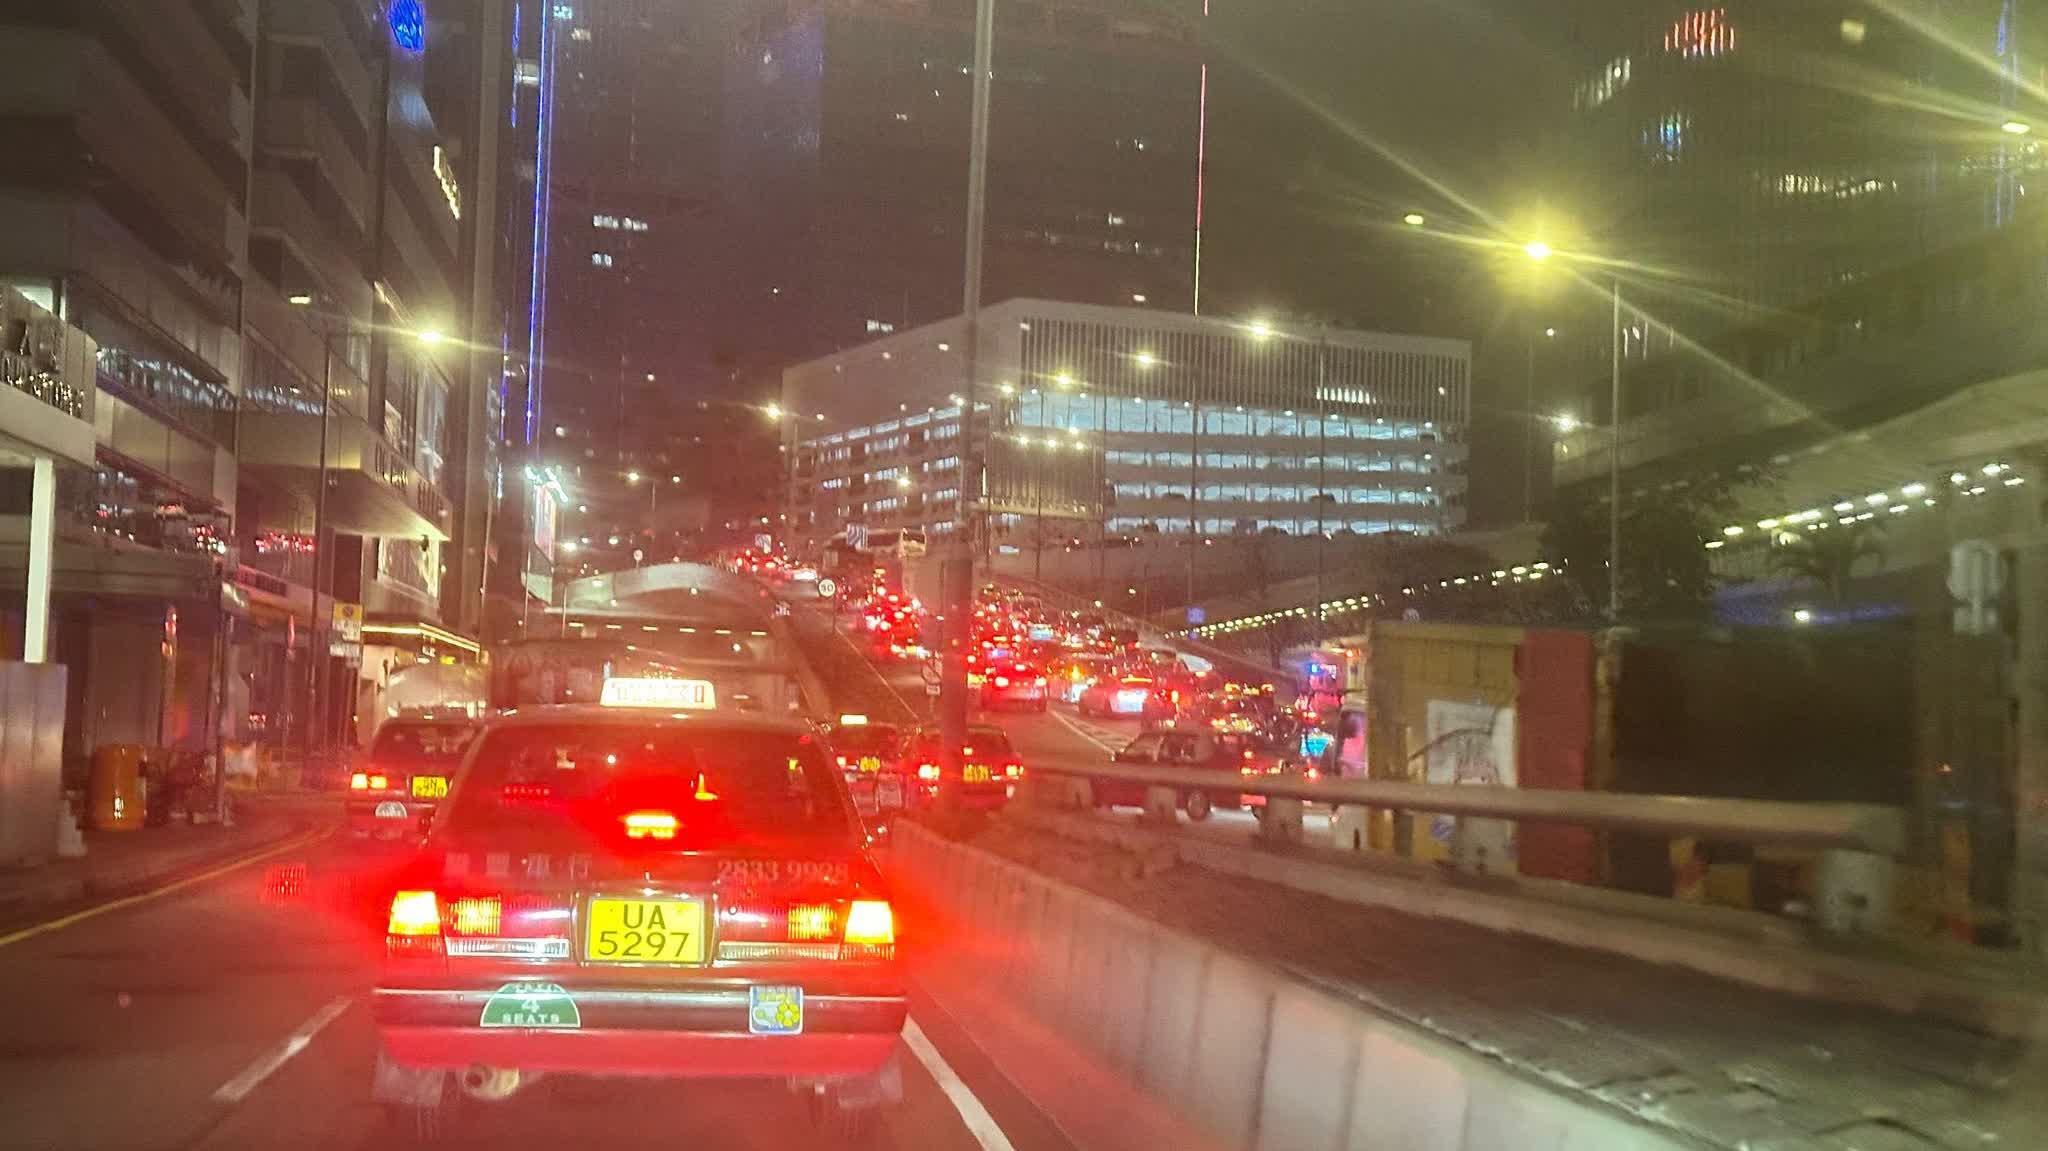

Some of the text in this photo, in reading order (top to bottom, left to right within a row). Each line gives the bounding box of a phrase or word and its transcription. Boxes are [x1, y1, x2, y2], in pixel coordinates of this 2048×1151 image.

[623, 904, 666, 929] UA
[598, 931, 690, 957] 5297
[521, 998, 541, 1013] 4
[502, 1013, 560, 1025] SEATS
